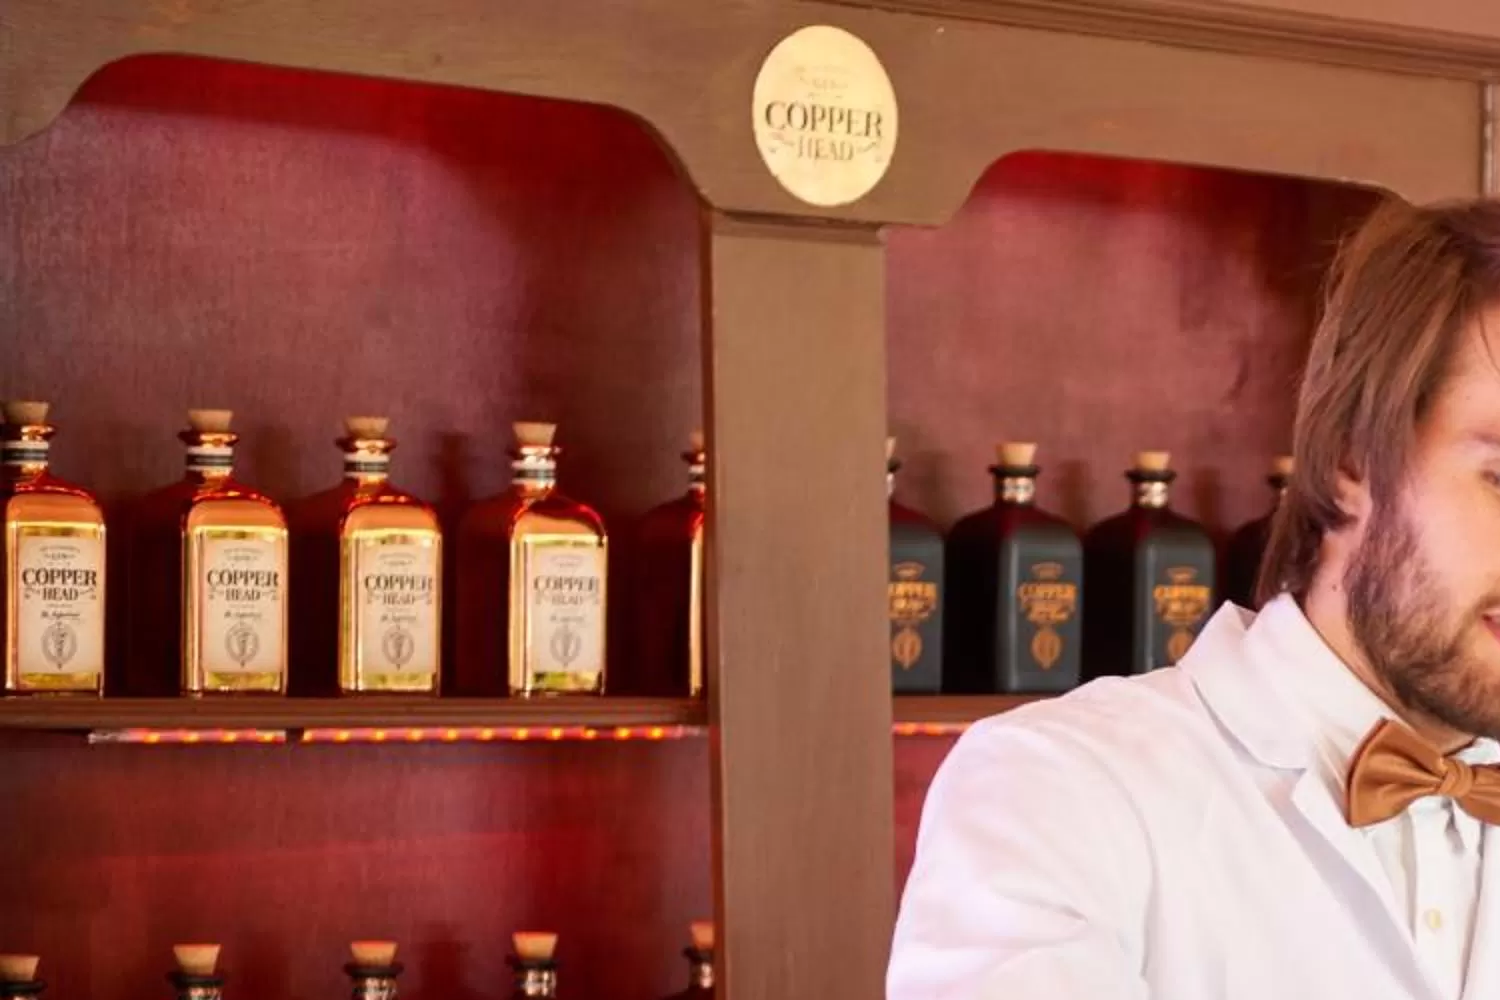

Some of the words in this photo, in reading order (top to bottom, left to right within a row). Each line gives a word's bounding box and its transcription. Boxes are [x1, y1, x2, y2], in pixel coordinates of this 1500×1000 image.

[765, 100, 883, 137] COPPER
[798, 136, 854, 161] HEAD
[22, 567, 97, 587] COPPER
[207, 569, 279, 588] COPPER
[42, 587, 79, 601] HEAD
[225, 588, 261, 602] HEAD
